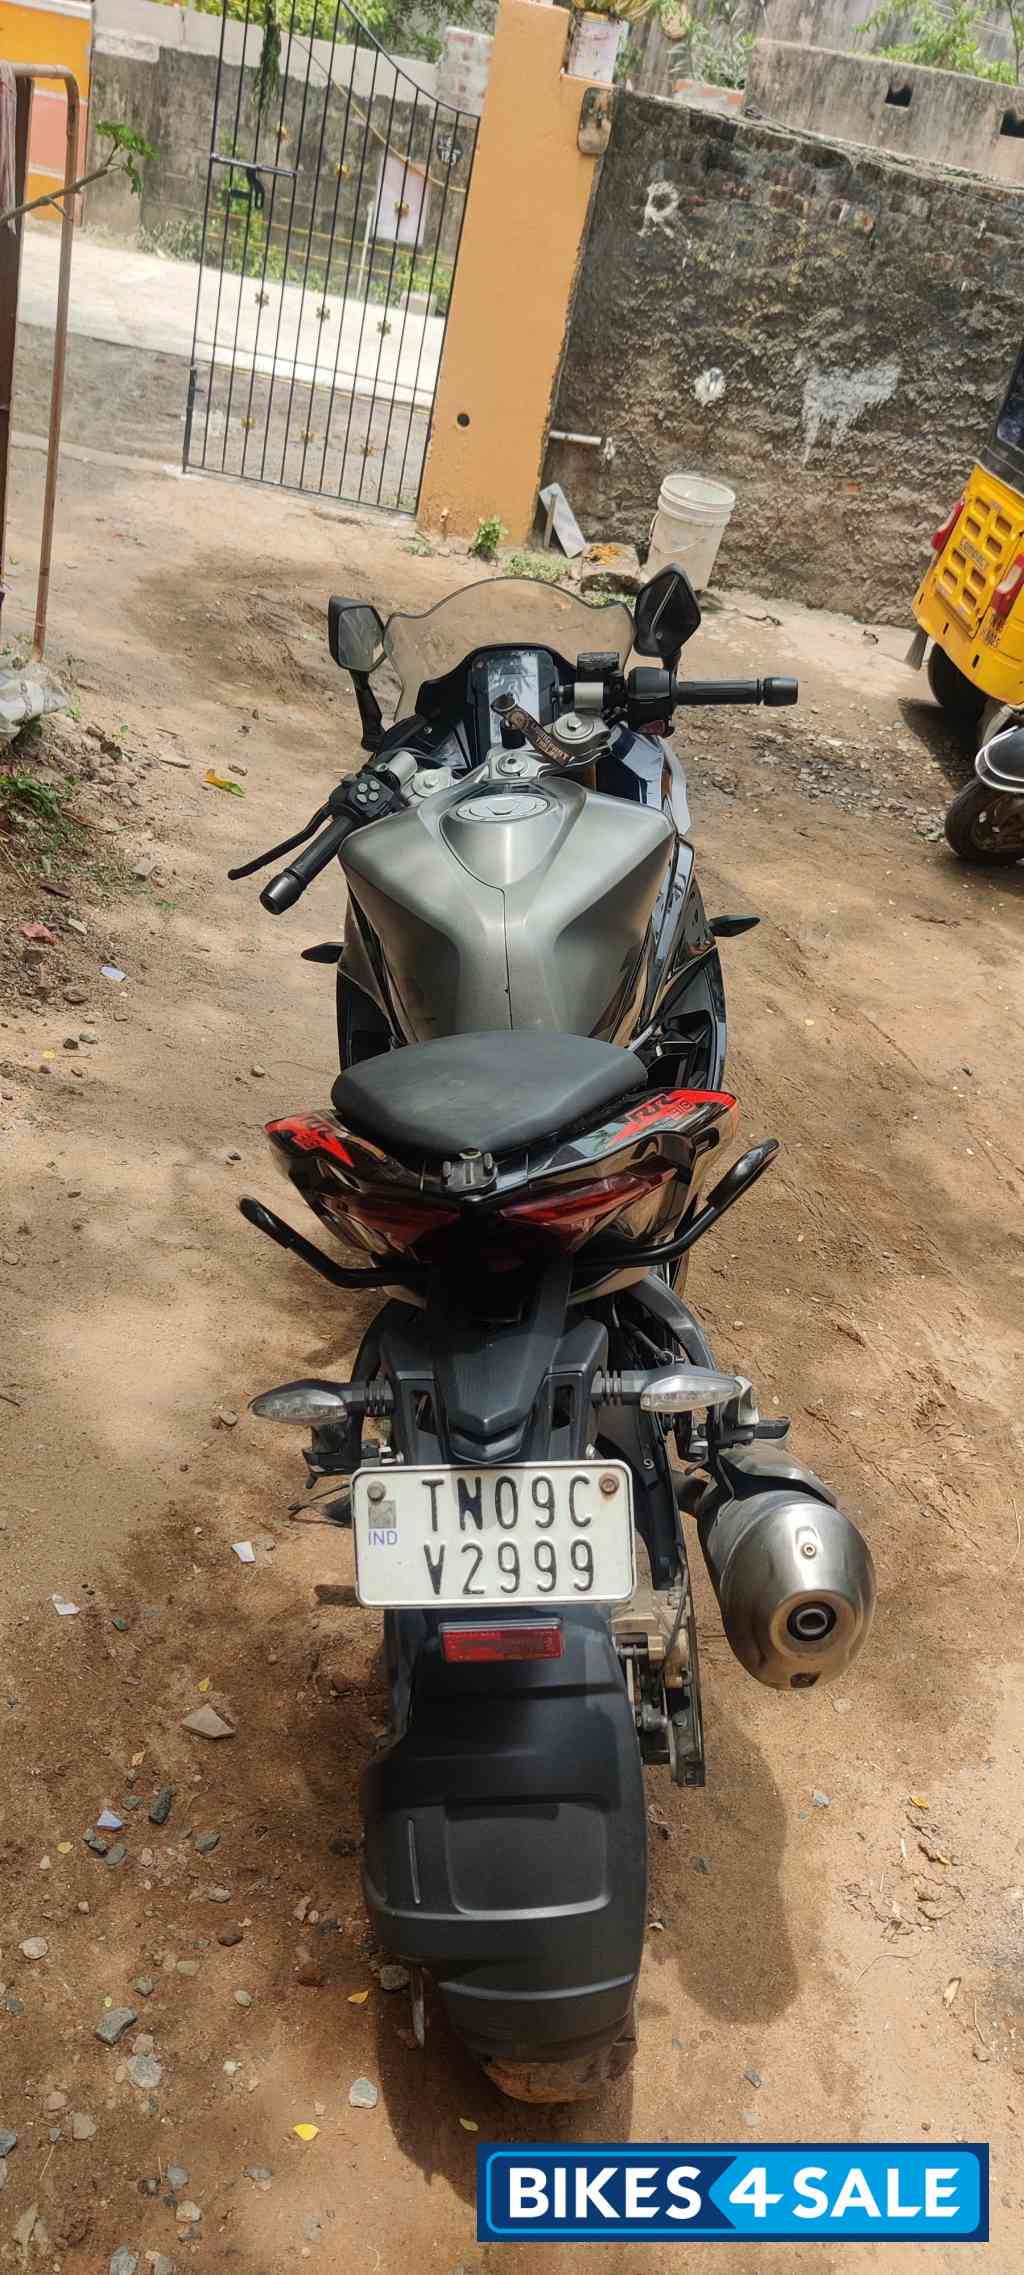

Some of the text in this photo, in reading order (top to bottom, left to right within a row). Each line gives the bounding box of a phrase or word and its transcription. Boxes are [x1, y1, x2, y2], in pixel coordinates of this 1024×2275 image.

[422, 1475, 592, 1531] TN09C
[368, 1530, 398, 1545] IND
[423, 1540, 594, 1595] V2999
